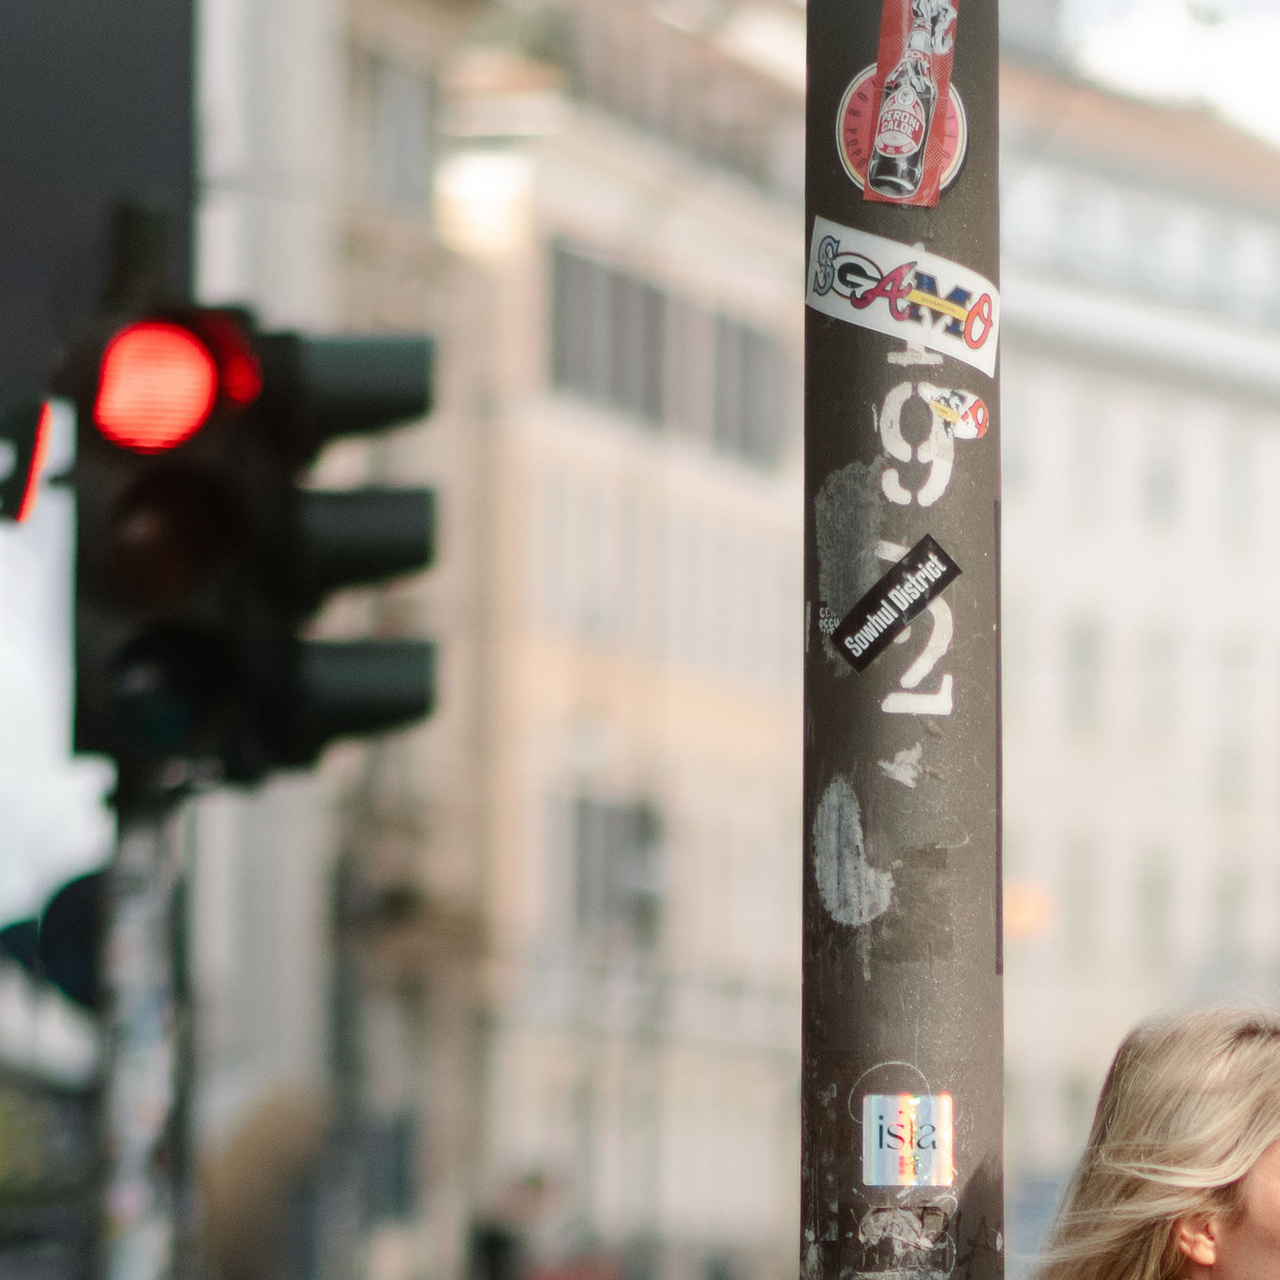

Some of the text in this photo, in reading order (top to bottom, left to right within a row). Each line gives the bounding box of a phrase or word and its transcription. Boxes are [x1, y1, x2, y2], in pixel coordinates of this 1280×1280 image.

[881, 119, 914, 138] CALDE
[882, 111, 920, 131] PERONI
[844, 552, 948, 658] Sowhul District
[878, 1112, 937, 1150] isla
